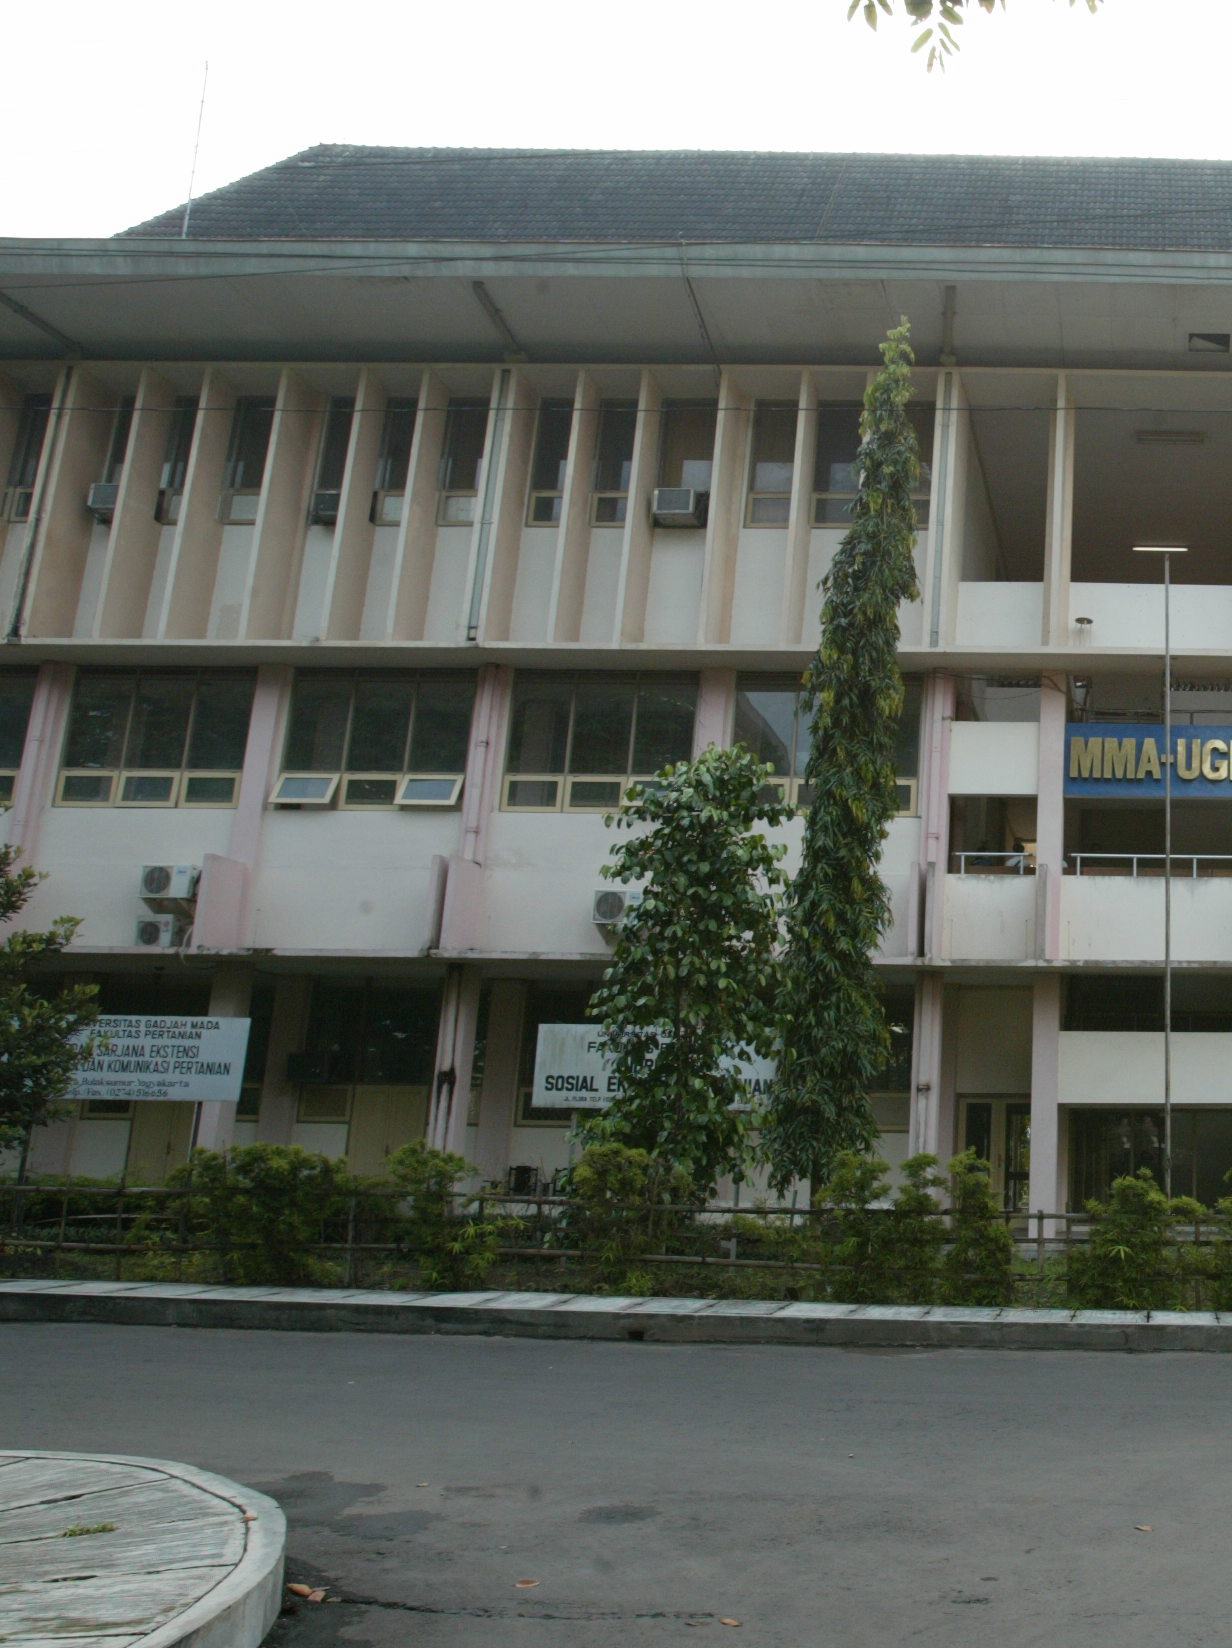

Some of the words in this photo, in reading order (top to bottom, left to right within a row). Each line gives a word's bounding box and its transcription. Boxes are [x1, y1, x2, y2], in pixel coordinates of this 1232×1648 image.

[145, 1020, 187, 1030] GADJAH
[190, 1021, 220, 1030] MADA
[144, 1030, 202, 1040] PERTANIAN
[149, 1045, 200, 1058] EKSTENSI
[107, 1059, 170, 1073] KOMUNIKASI
[173, 1061, 231, 1075] PERTANIAN
[545, 1075, 599, 1092] SOSIAL
